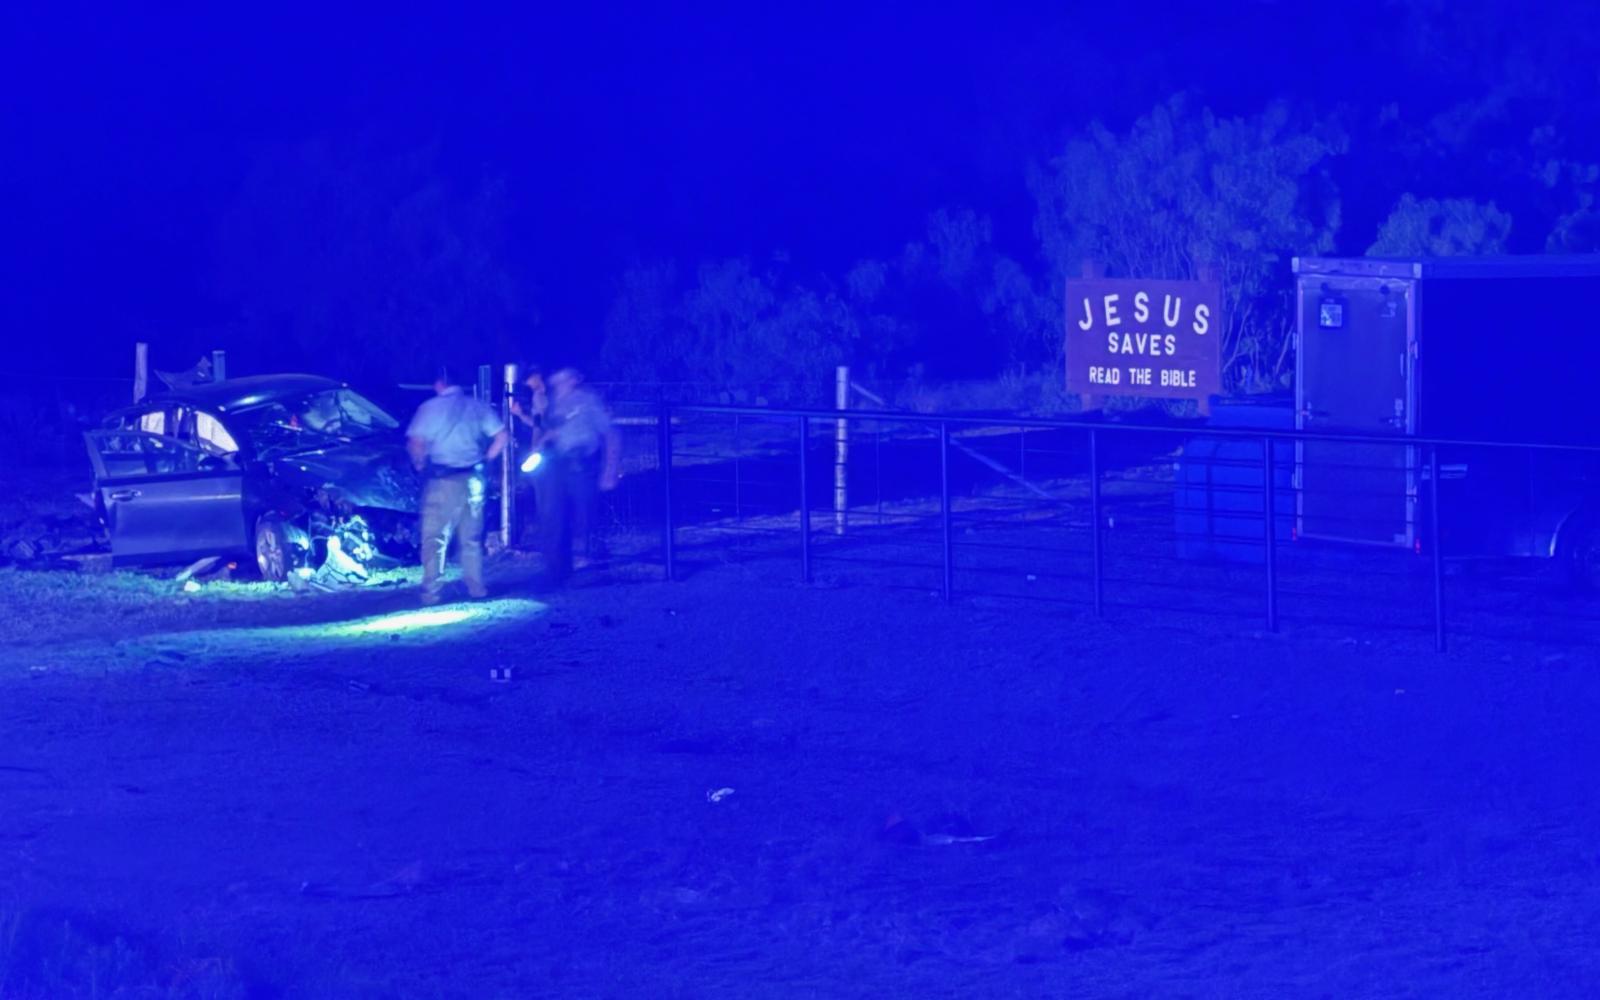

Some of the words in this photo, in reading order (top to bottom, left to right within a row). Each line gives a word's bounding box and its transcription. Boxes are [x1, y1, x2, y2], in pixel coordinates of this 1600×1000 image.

[1078, 291, 1210, 335] JESUS
[1108, 332, 1176, 356] SAVES
[1089, 366, 1120, 385] READ
[1128, 368, 1152, 385] THE
[1160, 369, 1197, 387] BIBLE
